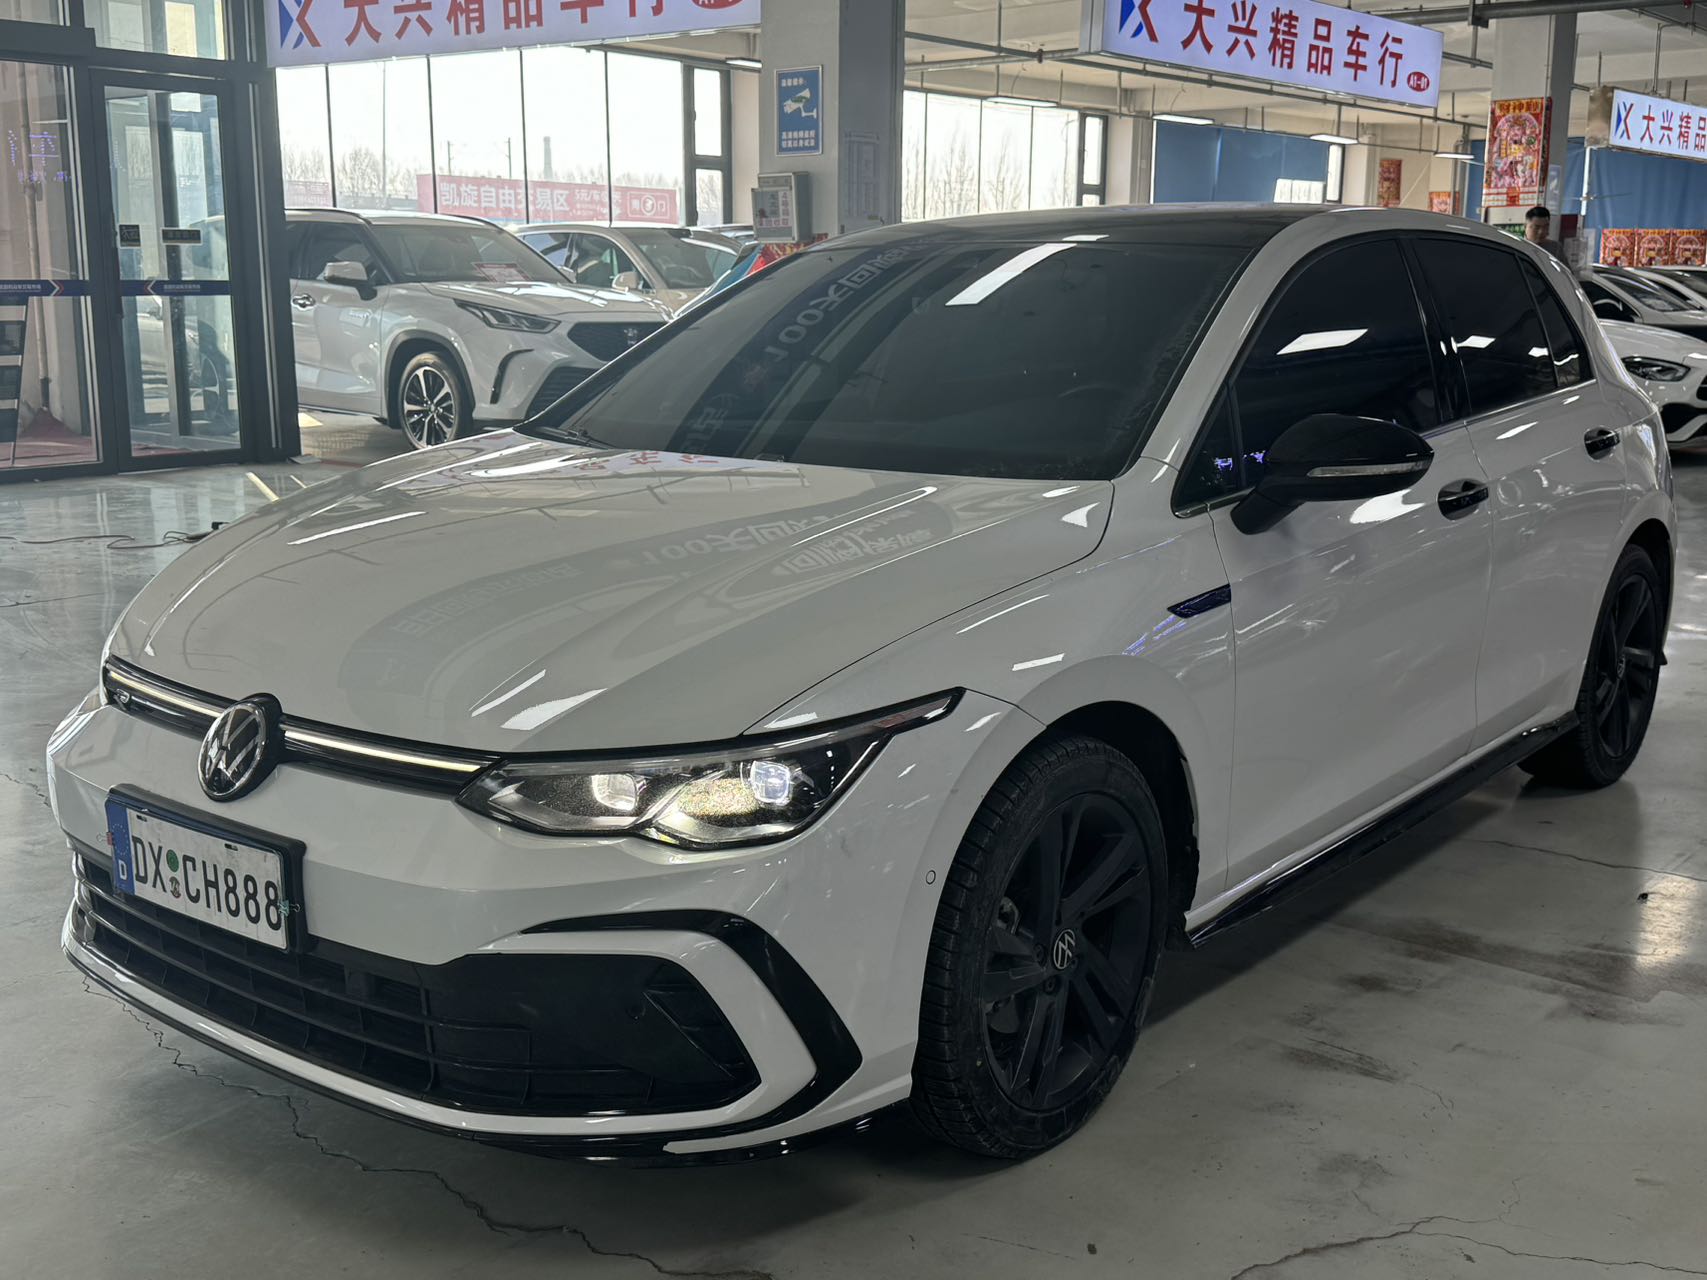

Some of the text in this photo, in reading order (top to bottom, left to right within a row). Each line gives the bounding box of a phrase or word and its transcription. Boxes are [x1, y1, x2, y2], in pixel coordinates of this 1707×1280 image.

[344, 0, 664, 47] 大兴精
[1181, 0, 1404, 88] 大兴精品车行
[440, 182, 569, 211] 凯旋自由交易区
[132, 834, 282, 931] DX CH888
